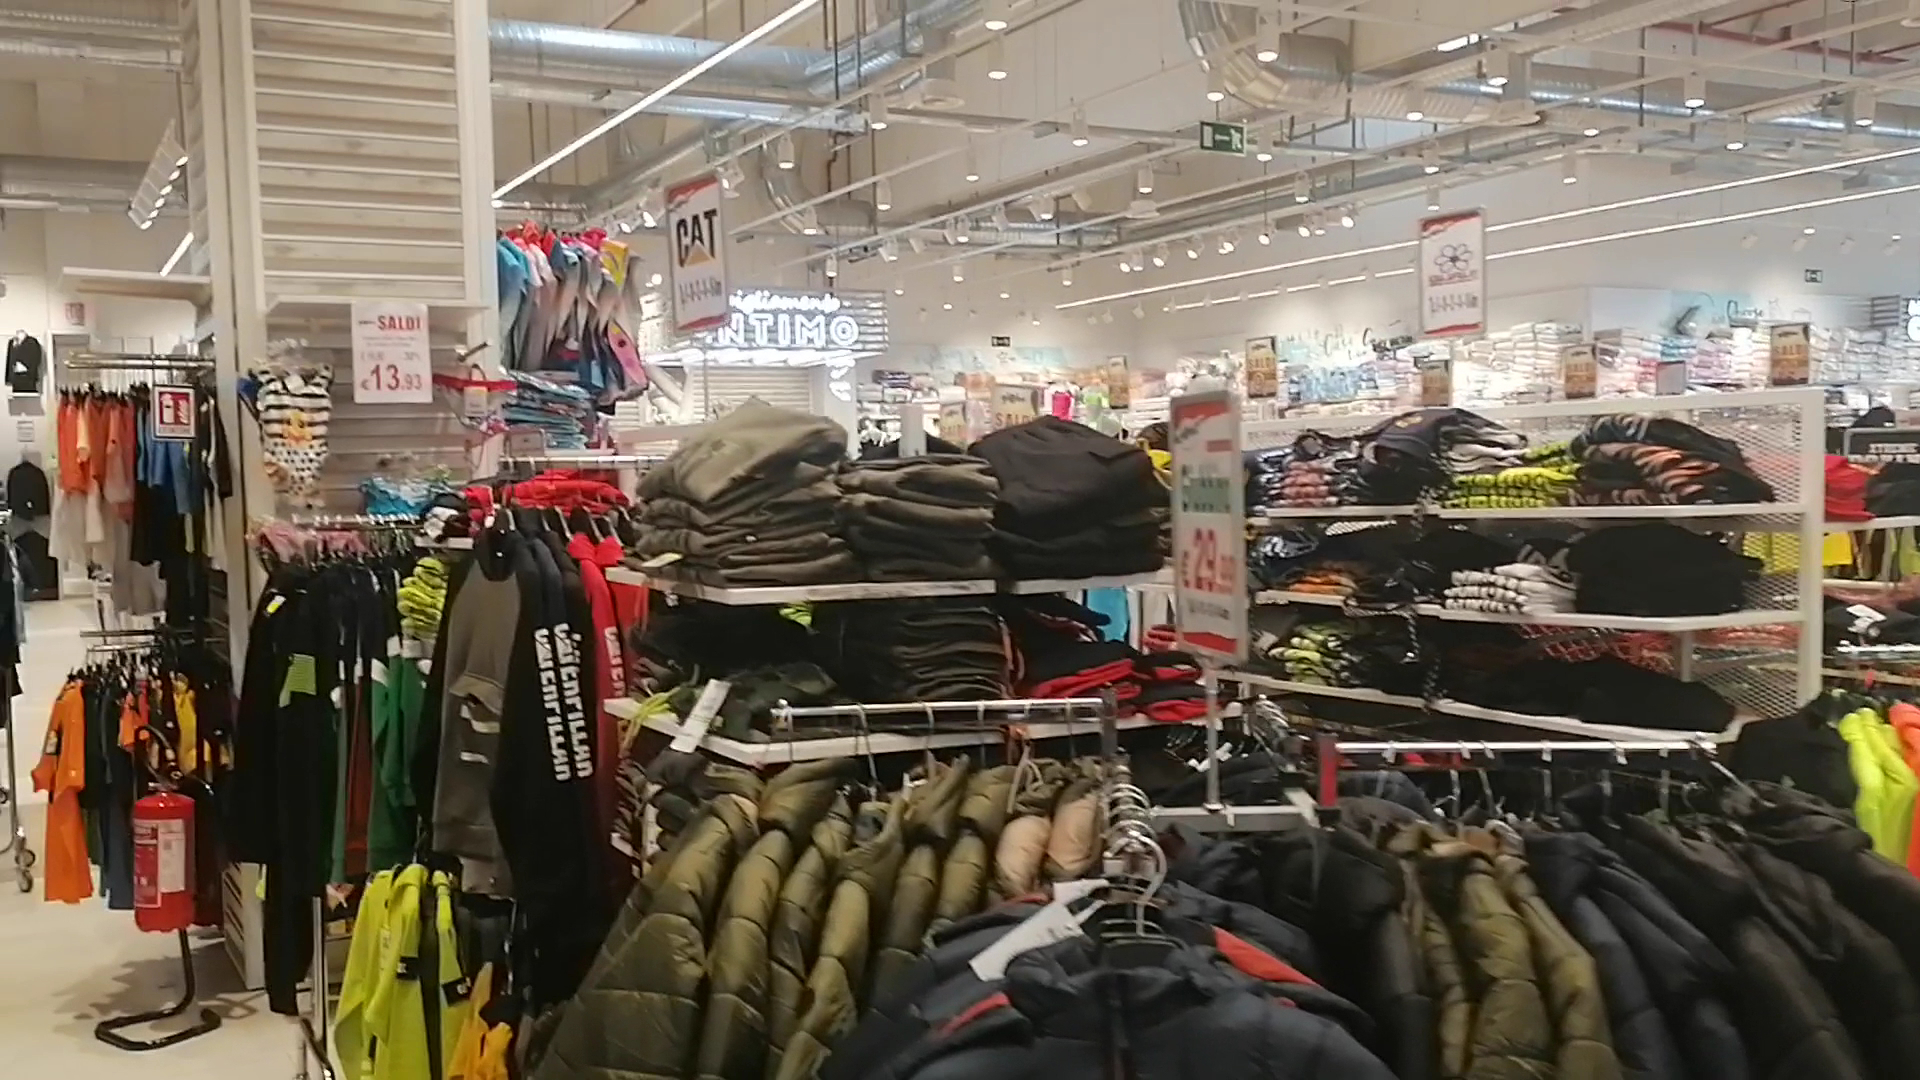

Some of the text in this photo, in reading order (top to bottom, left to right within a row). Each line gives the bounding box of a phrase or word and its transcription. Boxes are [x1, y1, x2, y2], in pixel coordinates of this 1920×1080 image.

[676, 208, 717, 268] CAT
[377, 315, 421, 331] SALDI
[706, 311, 860, 347] NTIMO
